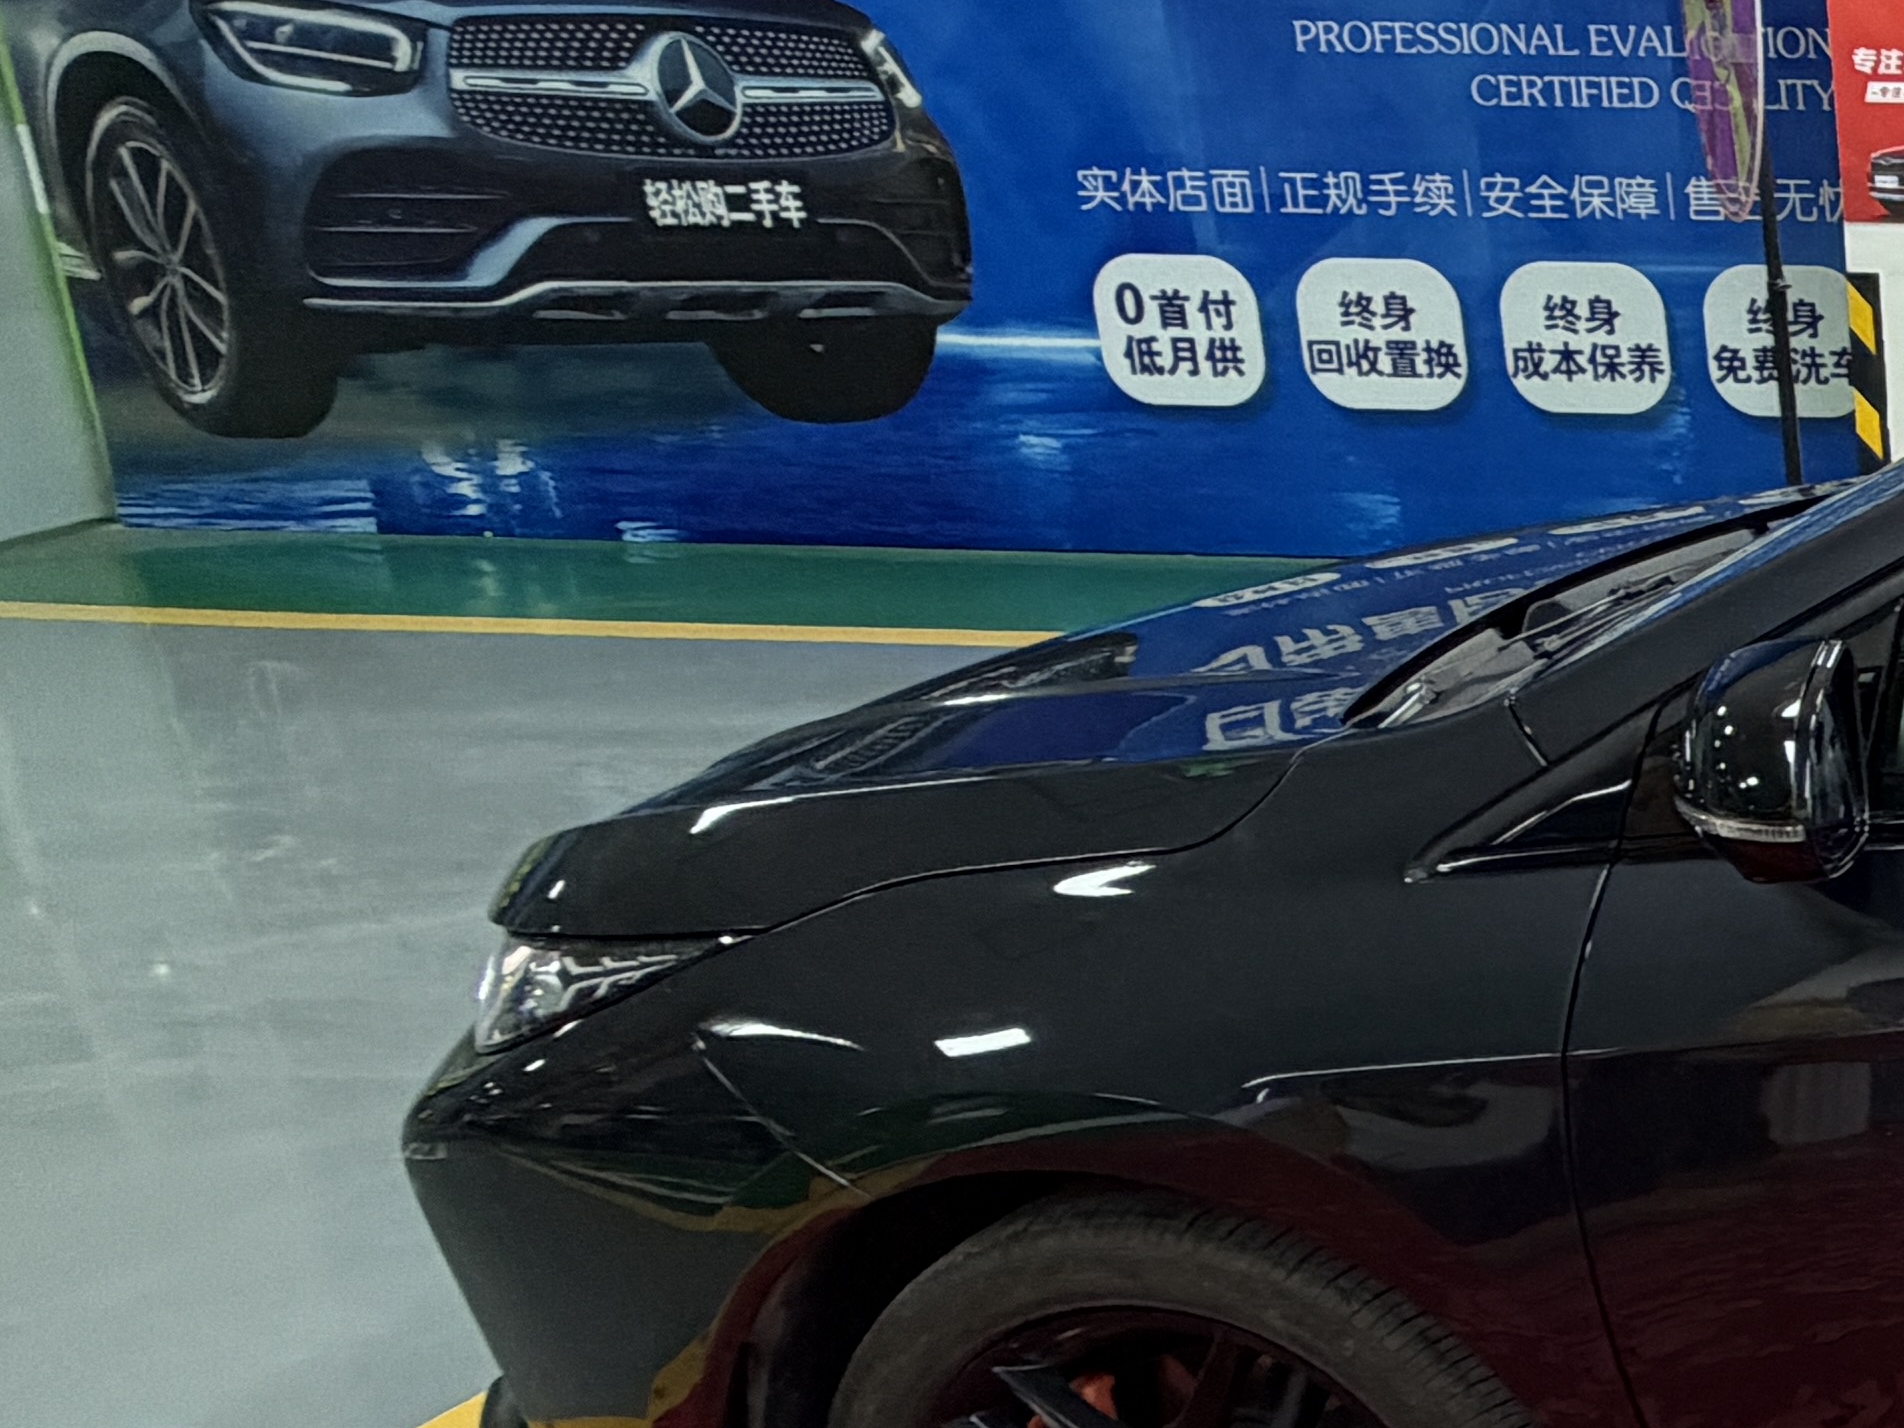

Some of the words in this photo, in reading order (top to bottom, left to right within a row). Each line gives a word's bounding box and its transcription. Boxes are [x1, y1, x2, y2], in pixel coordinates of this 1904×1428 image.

[1293, 19, 1581, 57] PROFESSIONAL
[1471, 75, 1661, 108] CERTIFIED
[643, 178, 808, 229] 轻松购二手车
[1076, 166, 1255, 212] 实体店面
[1278, 170, 1457, 216] 正规手续
[1479, 172, 1661, 220] 安全保障
[1114, 281, 1237, 331] 0首付
[1338, 290, 1417, 332] 终身
[1542, 294, 1622, 336] 终身
[1123, 335, 1246, 378] 低月供
[1307, 338, 1463, 380] 回收置换
[1512, 341, 1666, 384] 成本保养
